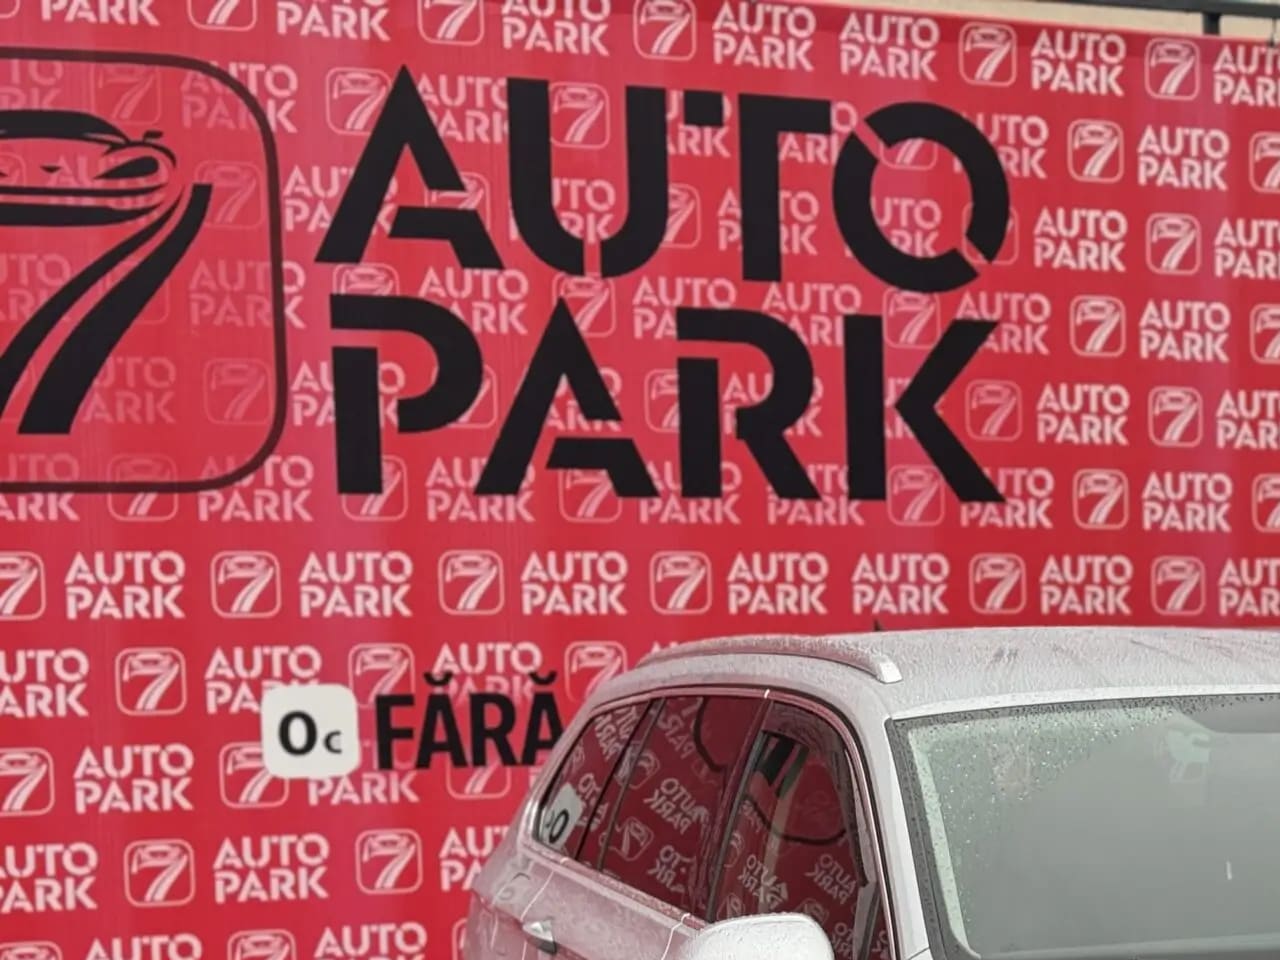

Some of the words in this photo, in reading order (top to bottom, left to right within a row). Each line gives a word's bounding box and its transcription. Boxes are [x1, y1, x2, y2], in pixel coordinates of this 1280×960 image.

[41, 0, 159, 26] PARK
[277, 0, 391, 41] PARK
[712, 0, 816, 38] AUTO
[839, 11, 940, 49] AUTO
[502, 20, 610, 56] PARK
[714, 32, 814, 72] PARK
[1031, 29, 1126, 65] AUTO
[839, 44, 938, 82] PARK
[1031, 60, 1124, 98] PARK
[1138, 125, 1230, 158] AUTO
[315, 64, 1010, 293] AUTO
[1138, 154, 1228, 192] PARK
[1034, 208, 1128, 240] AUTO
[1034, 238, 1126, 272] PARK
[634, 307, 677, 339] PA
[1140, 302, 1231, 332] AUTO
[981, 322, 1049, 355] ARK
[1140, 330, 1229, 364] PARK
[330, 294, 1008, 503] PARK
[1036, 384, 1130, 415] AUTO
[1038, 413, 1128, 446] PARK
[1144, 472, 1234, 502] AUTO
[198, 488, 313, 522] PARK
[1144, 500, 1232, 532] PARK
[65, 550, 185, 584] AUTO
[300, 550, 414, 584] AUTO
[520, 550, 628, 584] AUTO
[728, 552, 829, 584] AUTO
[852, 552, 950, 584] AUTO
[1040, 554, 1134, 584] AUTO
[66, 585, 185, 620] PARK
[300, 584, 412, 618] PARK
[522, 584, 628, 616] PARK
[728, 582, 828, 616] PARK
[852, 582, 948, 616] PARK
[1040, 582, 1132, 616] PARK
[205, 646, 321, 679] AUTO
[432, 642, 542, 675] AUTO
[375, 672, 565, 770] FĂRĂ
[74, 744, 194, 779] AUTO
[75, 778, 194, 814] PARK
[306, 770, 419, 806] PARK
[214, 834, 329, 868] AUTO
[214, 866, 328, 904] PARK
[315, 922, 428, 958] AUTO
